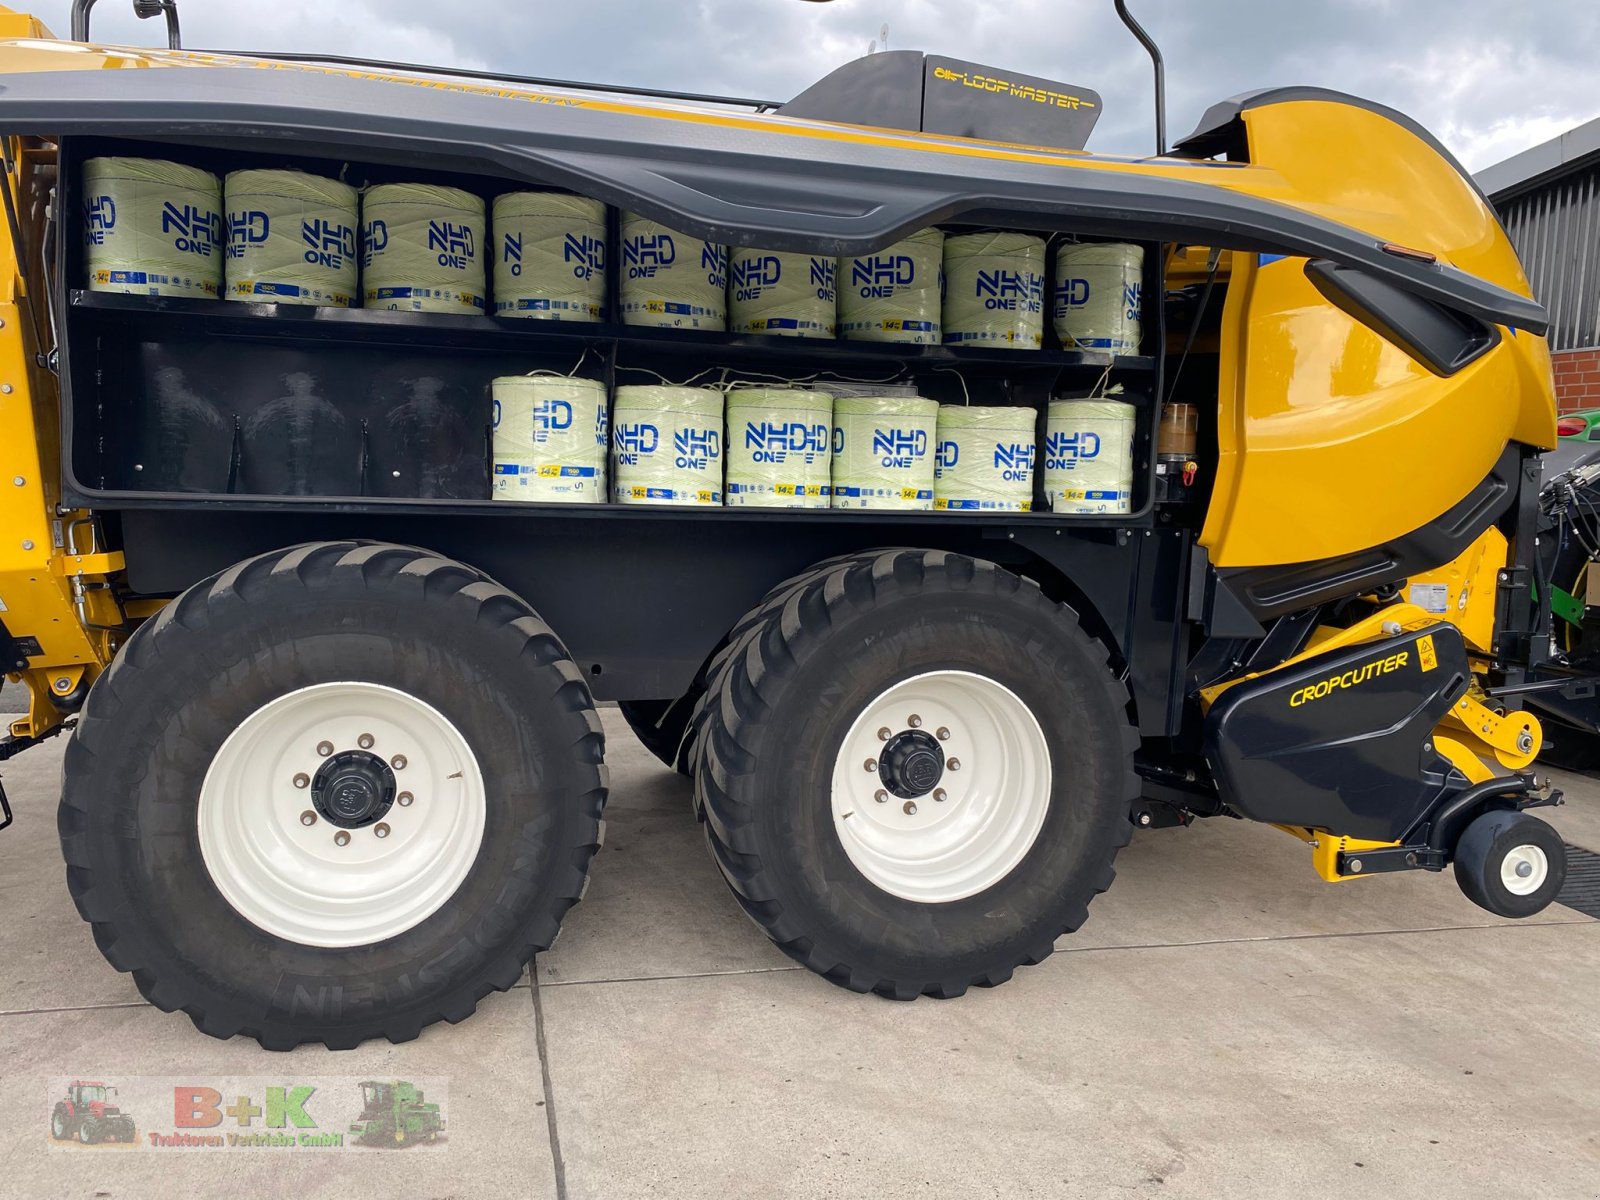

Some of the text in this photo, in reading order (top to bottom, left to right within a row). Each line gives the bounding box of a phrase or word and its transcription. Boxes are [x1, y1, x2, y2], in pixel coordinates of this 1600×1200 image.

[162, 201, 221, 247] NHD
[302, 218, 355, 259] NHD
[364, 220, 388, 252] HD
[429, 220, 474, 257] NHD
[175, 237, 211, 256] ONE
[623, 234, 675, 267] NHD
[304, 250, 342, 269] ONE
[438, 253, 467, 269] ONE
[629, 266, 658, 279] ONE
[732, 256, 781, 290] NHD
[852, 256, 914, 286] NHD
[708, 273, 726, 289] ONE
[736, 287, 761, 301] ONE
[817, 287, 834, 302] ONE
[860, 286, 894, 298] ONE
[985, 298, 1017, 310] ONE
[615, 423, 659, 453] NHD
[674, 428, 720, 458] NHD
[745, 421, 806, 451] NHD
[873, 428, 927, 456] NHD
[1046, 432, 1101, 458] NHD
[619, 453, 638, 465] ONE
[675, 456, 707, 470] ONE
[752, 451, 787, 463] ONE
[882, 456, 913, 468] ONE
[1046, 459, 1077, 470] ONE
[1003, 470, 1028, 481] ONE
[1289, 651, 1409, 707] CROPCUTTER
